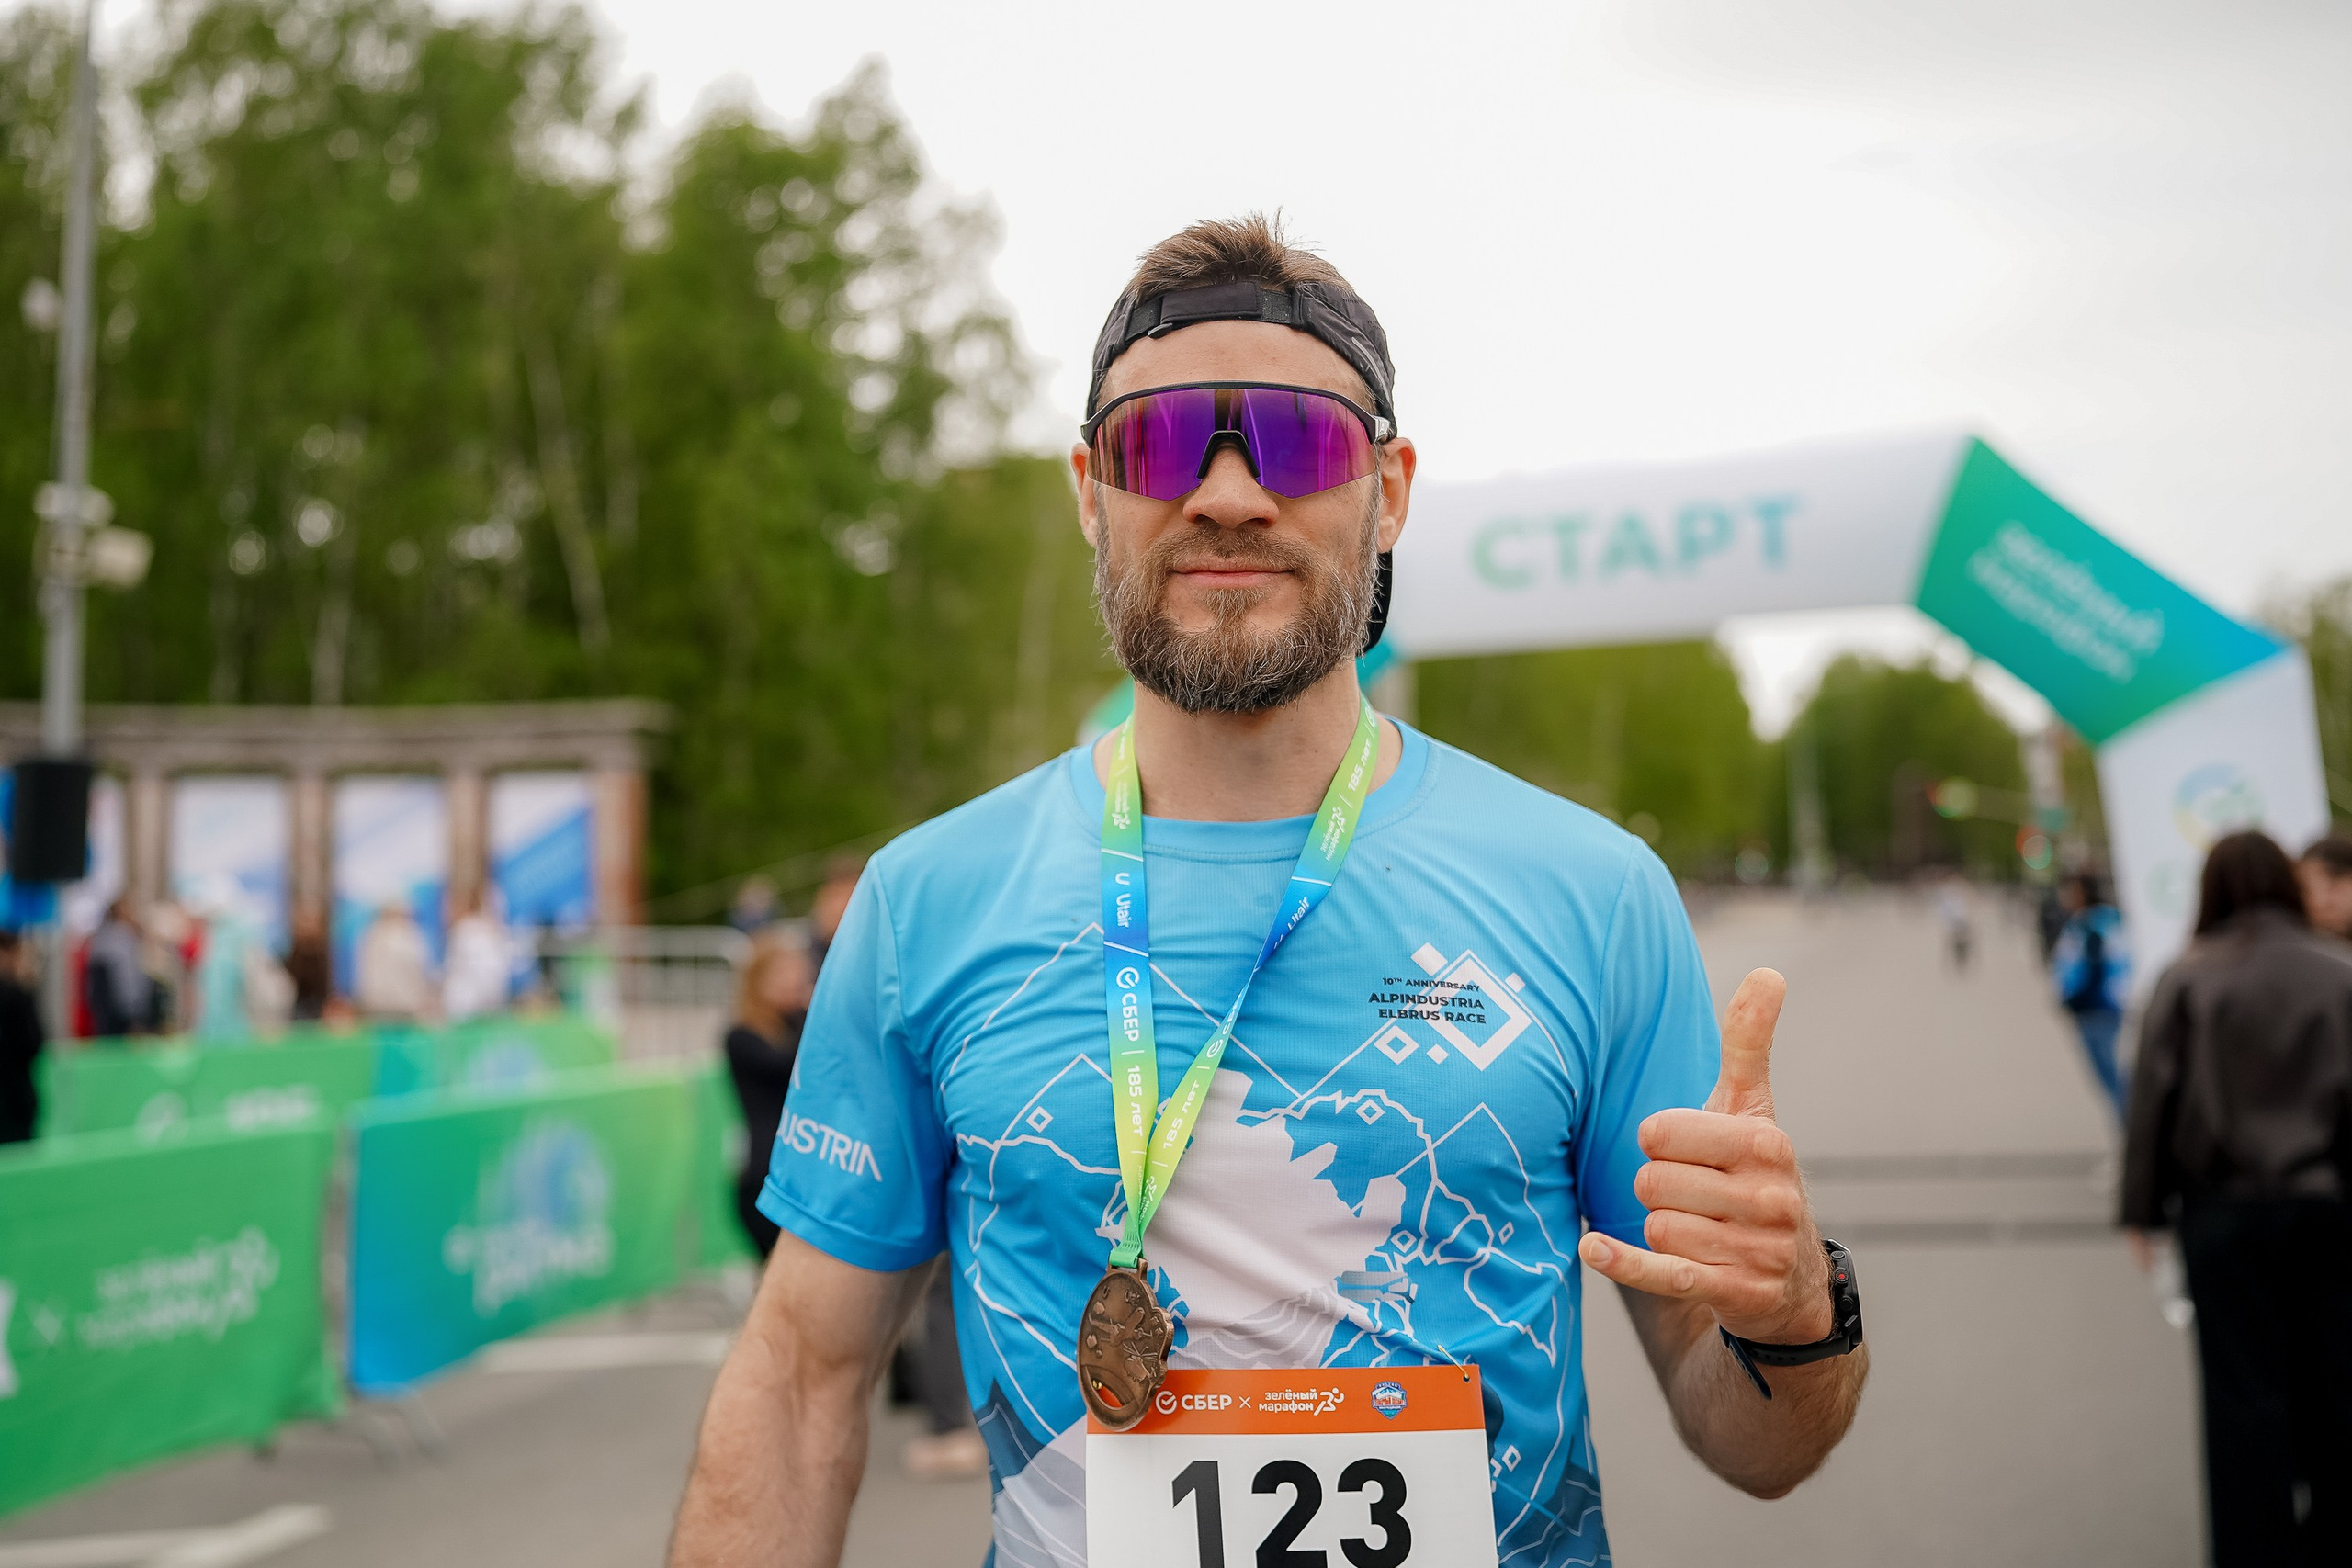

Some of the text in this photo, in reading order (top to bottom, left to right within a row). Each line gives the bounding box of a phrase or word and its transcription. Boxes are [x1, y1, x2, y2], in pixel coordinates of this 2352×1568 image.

[1472, 497, 1804, 592] СТАРТ
[1347, 764, 1363, 792] 185
[1115, 893, 1132, 928] Utair
[1405, 977, 1480, 992] ANNIVERSARY
[1368, 992, 1485, 1010] ALPINDUSTRIA
[1378, 1008, 1487, 1024] ELBRUS RACE
[1121, 992, 1139, 1042] СБЕР
[1126, 1065, 1143, 1097] 185
[1130, 1102, 1143, 1137] лет
[1163, 1117, 1182, 1149] 185
[1182, 1079, 1200, 1113] лет
[1181, 1394, 1233, 1411] СБЕР
[1259, 1401, 1314, 1414] марафон
[1264, 1388, 1318, 1401] зелёный
[1171, 1458, 1412, 1568] 123
